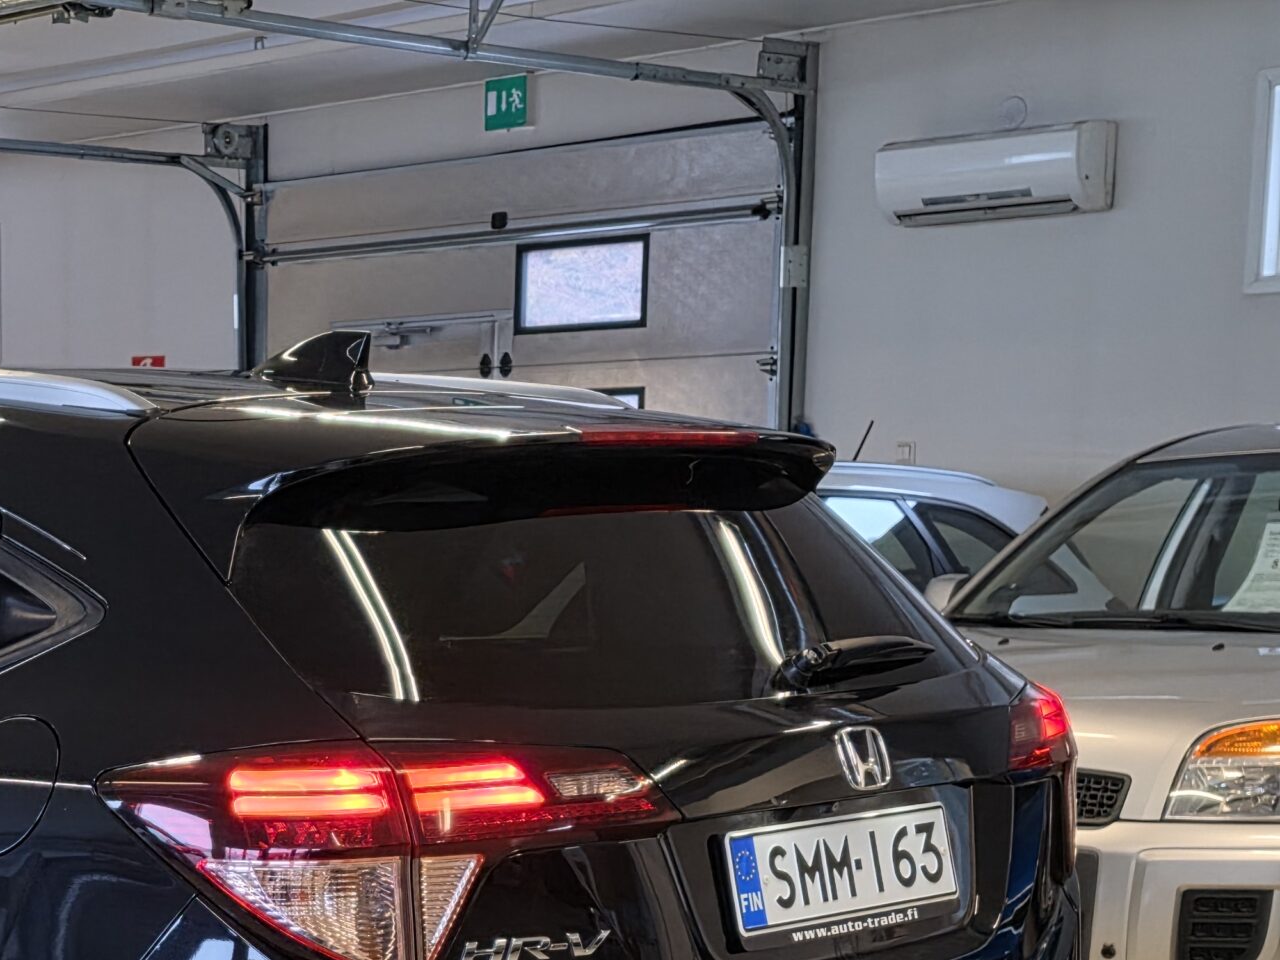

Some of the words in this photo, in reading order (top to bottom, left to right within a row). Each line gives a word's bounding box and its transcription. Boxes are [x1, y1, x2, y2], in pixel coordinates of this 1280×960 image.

[739, 890, 764, 913] FIN
[768, 821, 943, 909] SMM-163
[791, 907, 919, 942] www.auto-trade.fi
